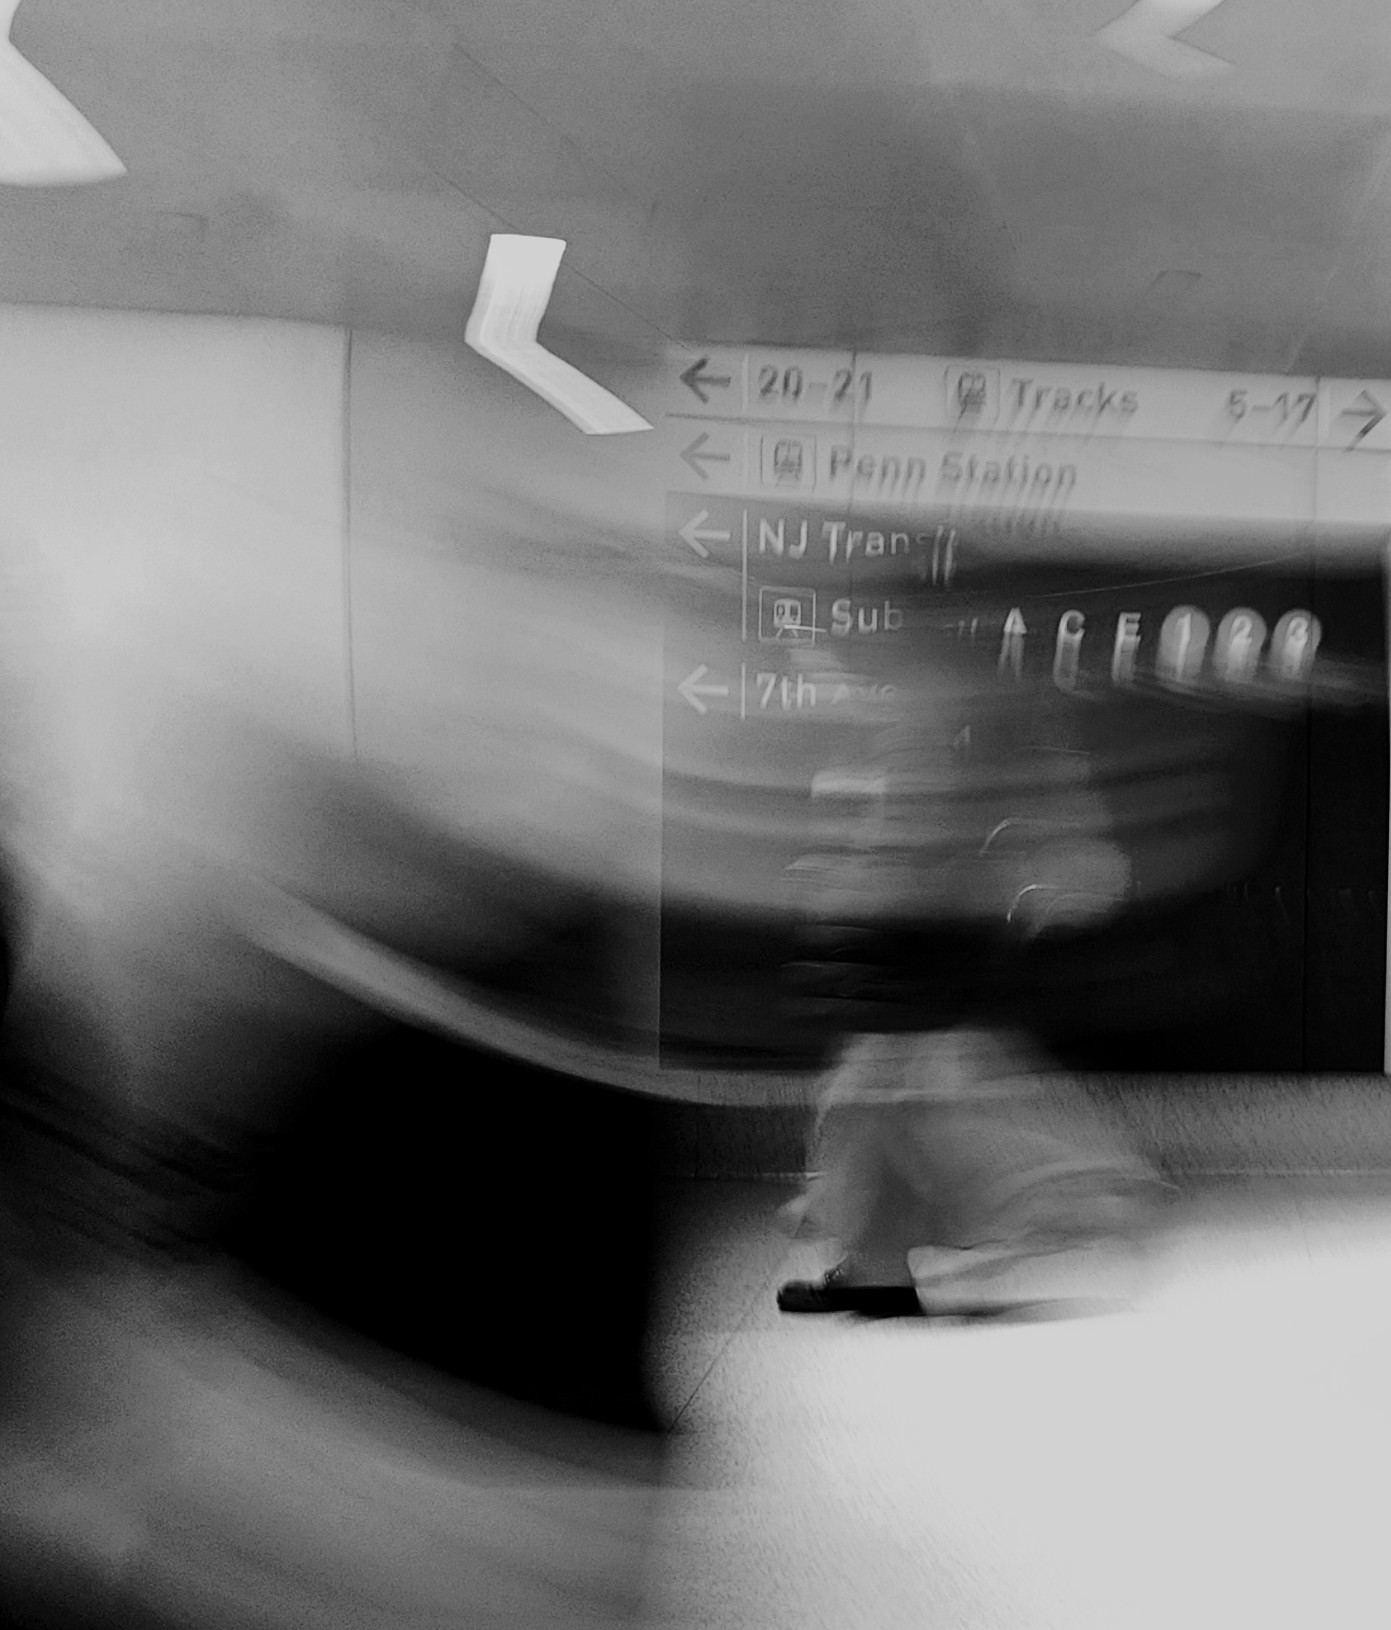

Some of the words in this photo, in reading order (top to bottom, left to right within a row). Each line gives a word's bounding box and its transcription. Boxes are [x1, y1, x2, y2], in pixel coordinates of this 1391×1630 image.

[1012, 378, 1139, 420] Tracks
[830, 444, 927, 492] Penn
[938, 450, 1079, 496] Station
[759, 518, 808, 559] NJ
[757, 672, 817, 709] 7th
